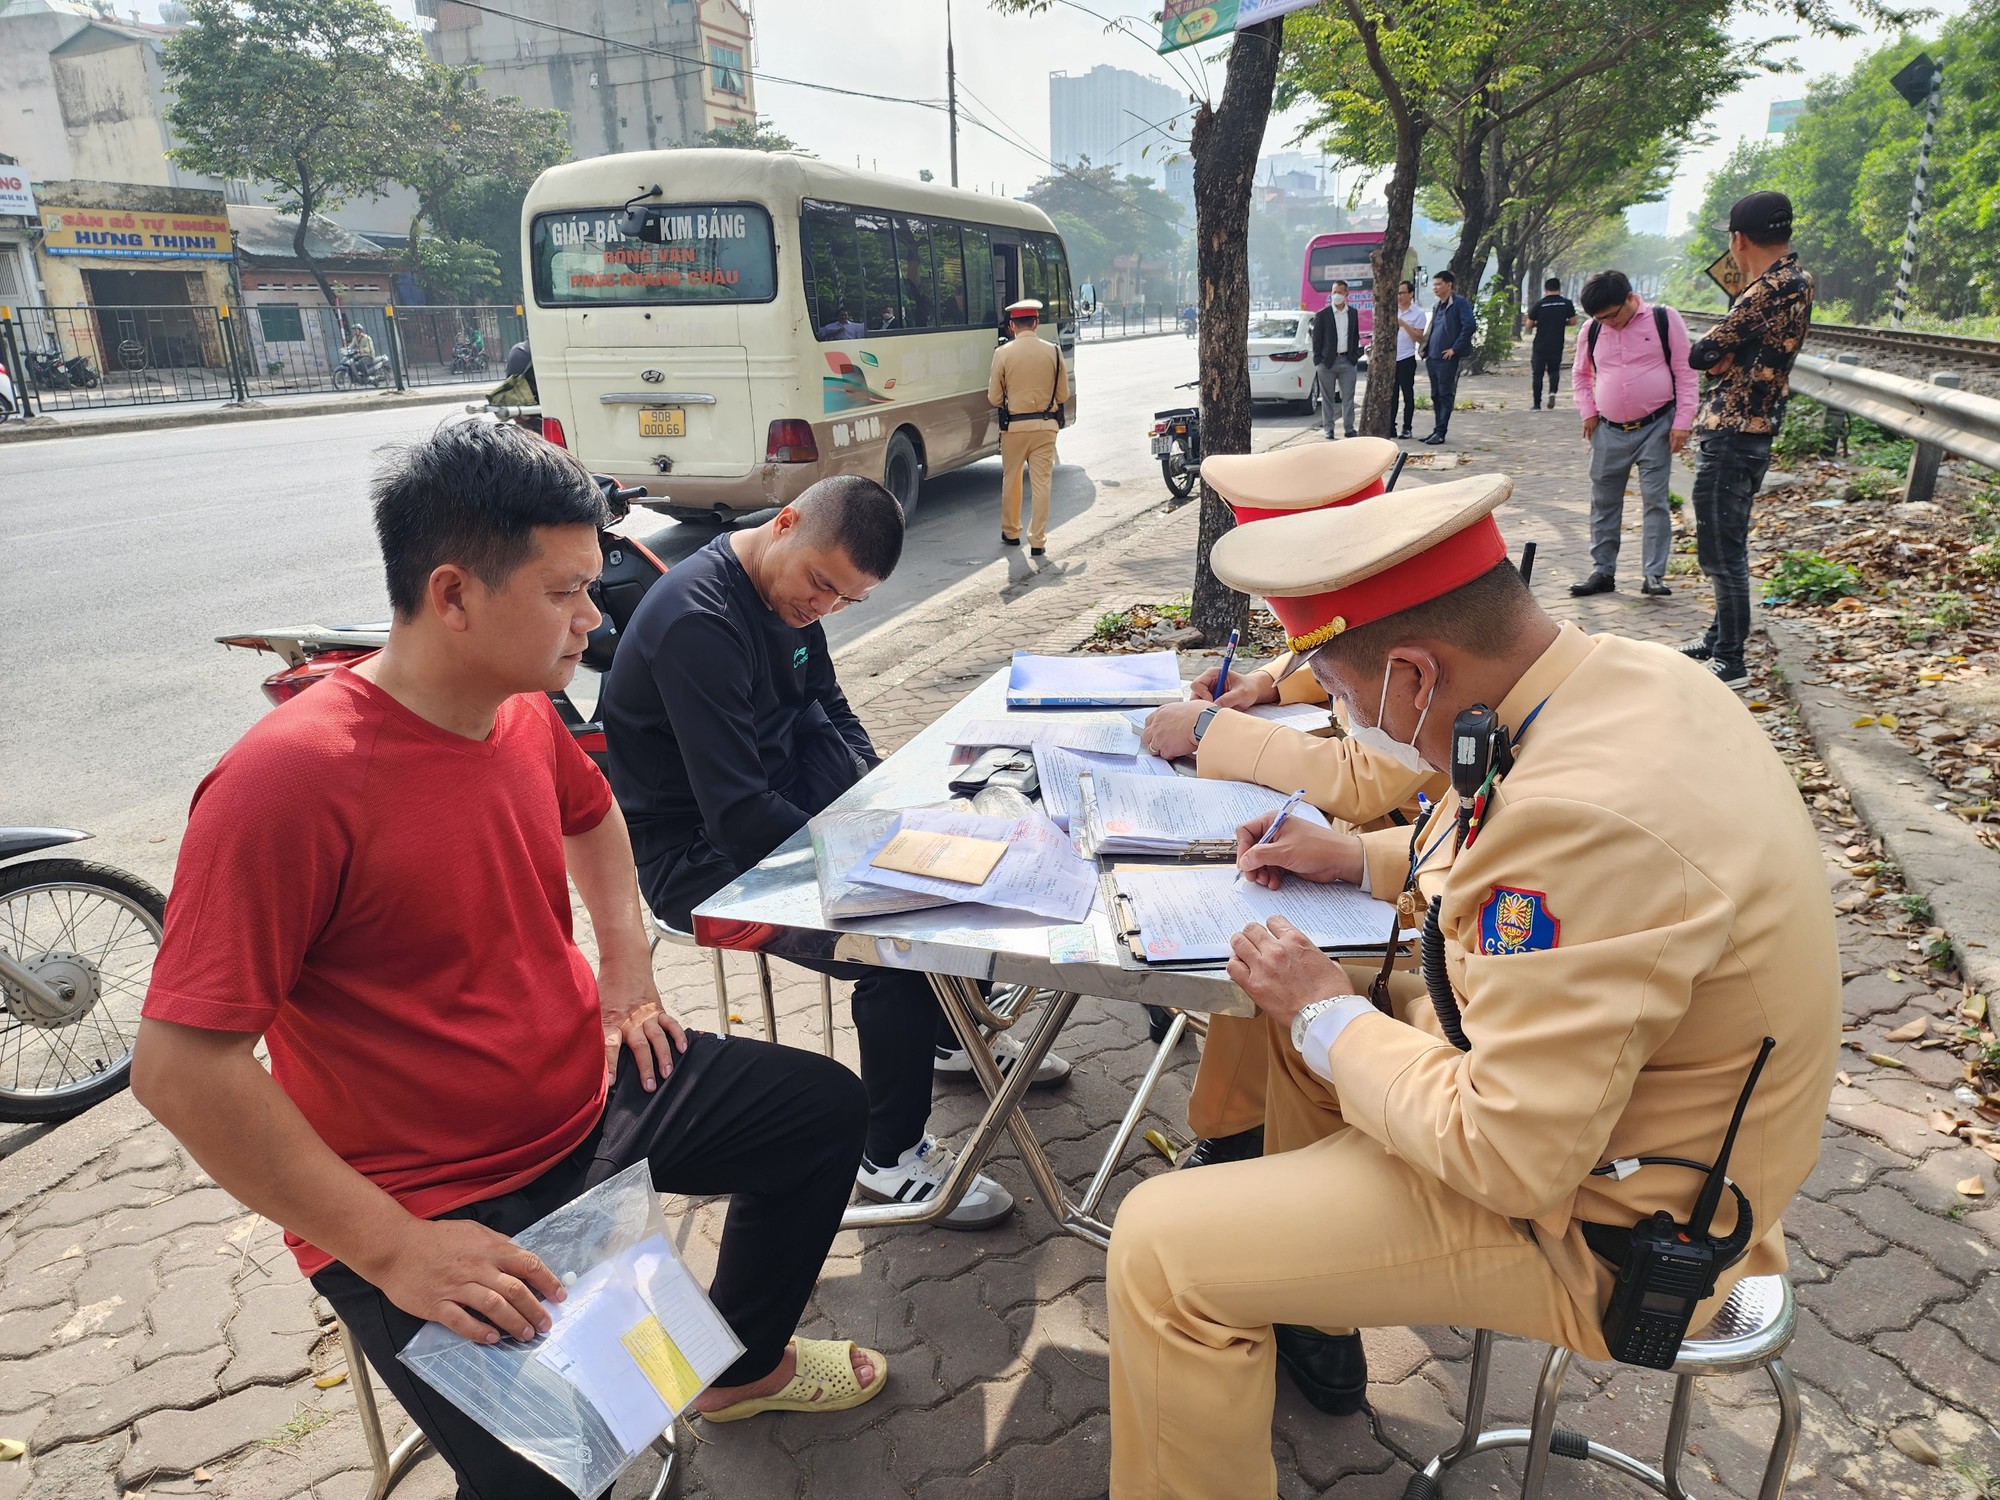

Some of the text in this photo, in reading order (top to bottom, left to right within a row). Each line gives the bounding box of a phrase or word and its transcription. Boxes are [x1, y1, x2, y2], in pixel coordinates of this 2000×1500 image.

[552, 216, 590, 246] GIÁP
[660, 215, 693, 241] KIM
[697, 208, 746, 239] BẢNG
[75, 231, 216, 250] HƯNG THỊNH
[619, 271, 682, 287] KHANG
[688, 266, 739, 286] CHÂU
[652, 411, 671, 423] 90B
[644, 423, 680, 435] 000.66
